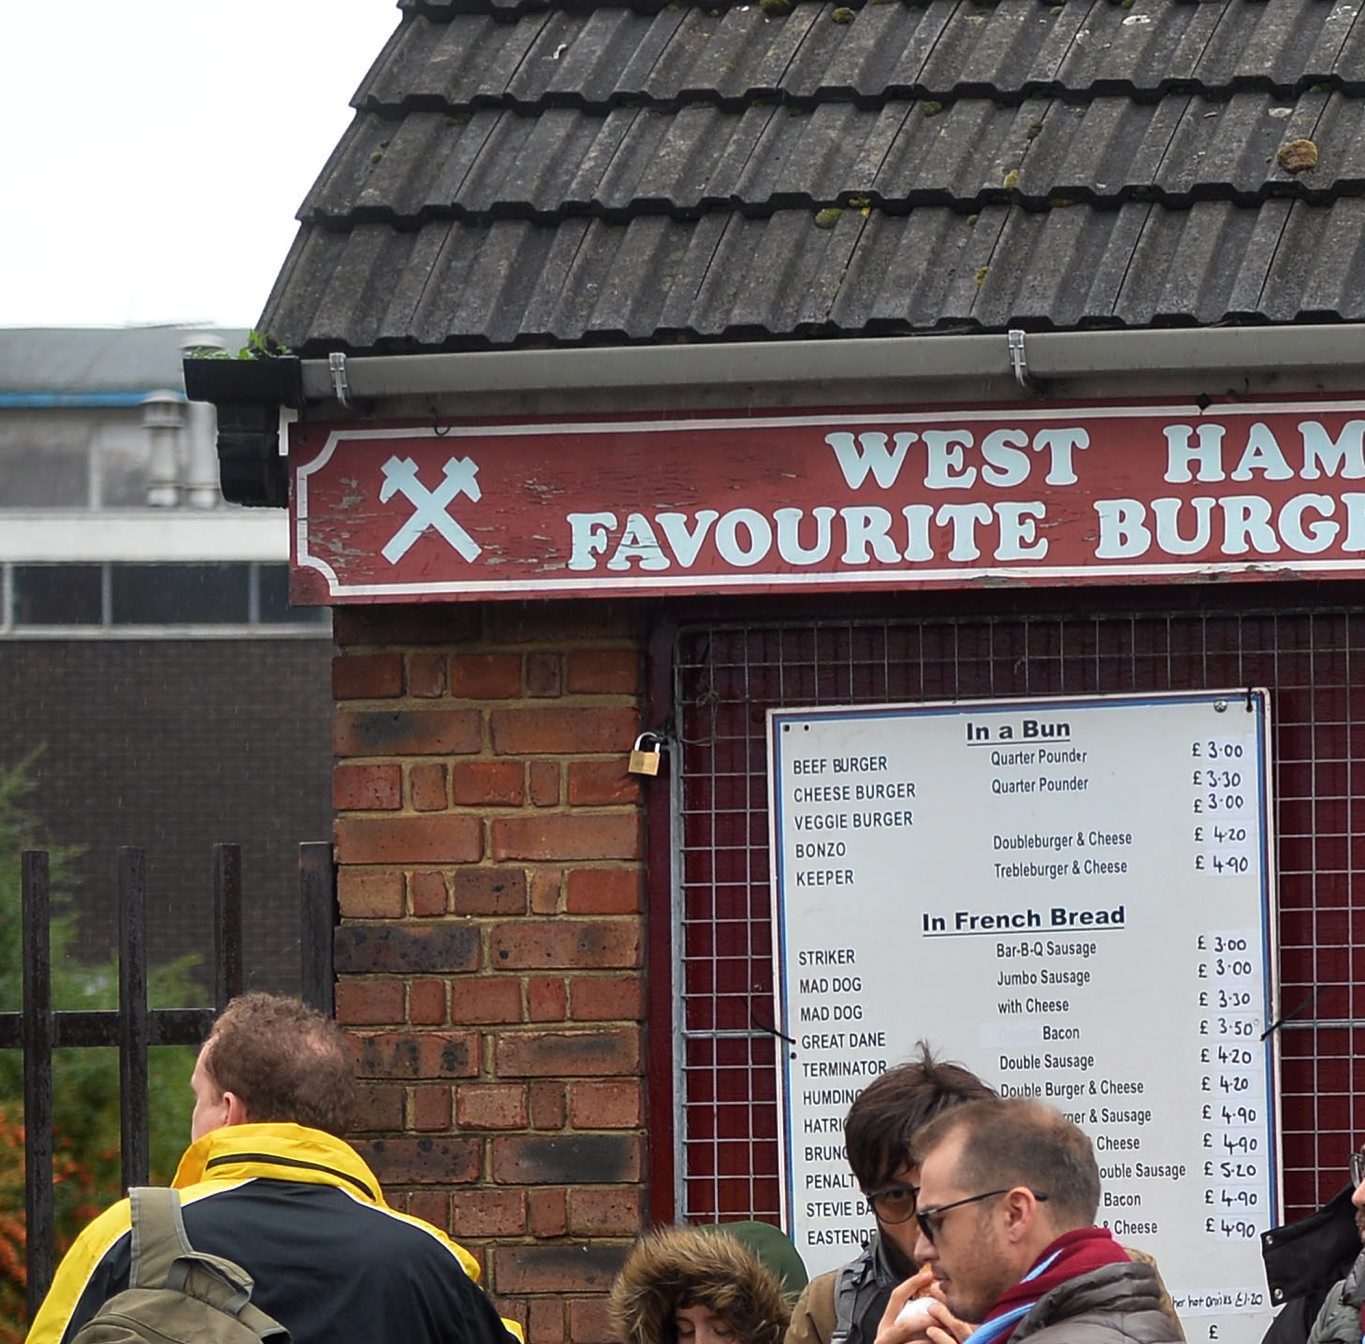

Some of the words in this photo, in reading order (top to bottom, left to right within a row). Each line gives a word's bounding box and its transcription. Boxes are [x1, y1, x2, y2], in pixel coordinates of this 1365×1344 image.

[825, 427, 1091, 490] WEST
[564, 500, 1050, 571] FAVOURITE
[967, 723, 991, 745] In
[999, 726, 1015, 743] a
[1023, 720, 1070, 742] Bun
[794, 759, 827, 774] BEEF
[833, 756, 887, 773] BURGER
[992, 751, 1035, 766] Quarter
[1039, 748, 1087, 763] Pounder
[1192, 743, 1201, 756] £
[794, 786, 850, 802] CHEESE
[856, 783, 915, 799] BURGER
[992, 779, 1035, 794] Quarter
[1040, 776, 1088, 791] Pounder
[1193, 771, 1202, 785] £
[795, 814, 847, 830] VEGGIE
[853, 811, 912, 827] BURGER
[1194, 799, 1202, 813] £
[796, 842, 845, 858] BONZO
[994, 834, 1072, 851] Doubleburger
[1077, 832, 1084, 846] &
[1089, 832, 1131, 845] Cheese
[1195, 827, 1203, 841] £
[797, 870, 853, 886] KEEPER
[995, 862, 1068, 879] Trebleburger
[1072, 860, 1080, 874] &
[1084, 860, 1127, 874] Cheese
[1196, 855, 1204, 869] £
[923, 914, 948, 935] In
[956, 910, 1043, 932] French
[1051, 906, 1124, 929] Bread
[799, 950, 854, 965] STRIKER
[997, 942, 1043, 957] Bar-B-Q
[1047, 941, 1096, 958] Sausage
[1198, 936, 1206, 949] £
[800, 979, 828, 993] MAD
[833, 977, 861, 992] DOG
[998, 971, 1037, 985] Jumbo
[1041, 970, 1090, 986] Sausage
[1199, 964, 1207, 978] £
[801, 1007, 829, 1021] MAD
[834, 1005, 862, 1020] DOG
[998, 999, 1022, 1013] with
[1026, 998, 1069, 1012] Cheese
[1200, 992, 1208, 1006] £
[802, 1034, 845, 1049] GREAT
[850, 1032, 885, 1047] DANE
[1043, 1026, 1079, 1040] Bacon
[1200, 1020, 1208, 1034] £
[802, 1060, 887, 1077] TERMINATOR
[1000, 1055, 1040, 1069] Double
[1045, 1054, 1094, 1071] Sausage
[1201, 1049, 1209, 1062] £
[1000, 1083, 1042, 1098] Double
[1046, 1082, 1084, 1099] Burger
[1089, 1080, 1096, 1095] &
[1101, 1080, 1143, 1094] Cheese
[1202, 1077, 1210, 1091] £
[1090, 1109, 1097, 1123] &
[1102, 1108, 1151, 1125] Sausage
[1203, 1105, 1211, 1119] £
[1097, 1136, 1139, 1150] Cheese
[1204, 1133, 1212, 1147] £
[806, 1174, 856, 1189] PENALT
[1100, 1164, 1132, 1179] ouble
[1136, 1163, 1185, 1180] Sausage
[1204, 1161, 1213, 1175] £
[807, 1202, 852, 1217] STEVIE
[1104, 1193, 1140, 1206] Bacon
[1206, 1190, 1214, 1204] £
[1115, 1220, 1157, 1234] Cheese
[1206, 1218, 1215, 1232] £
